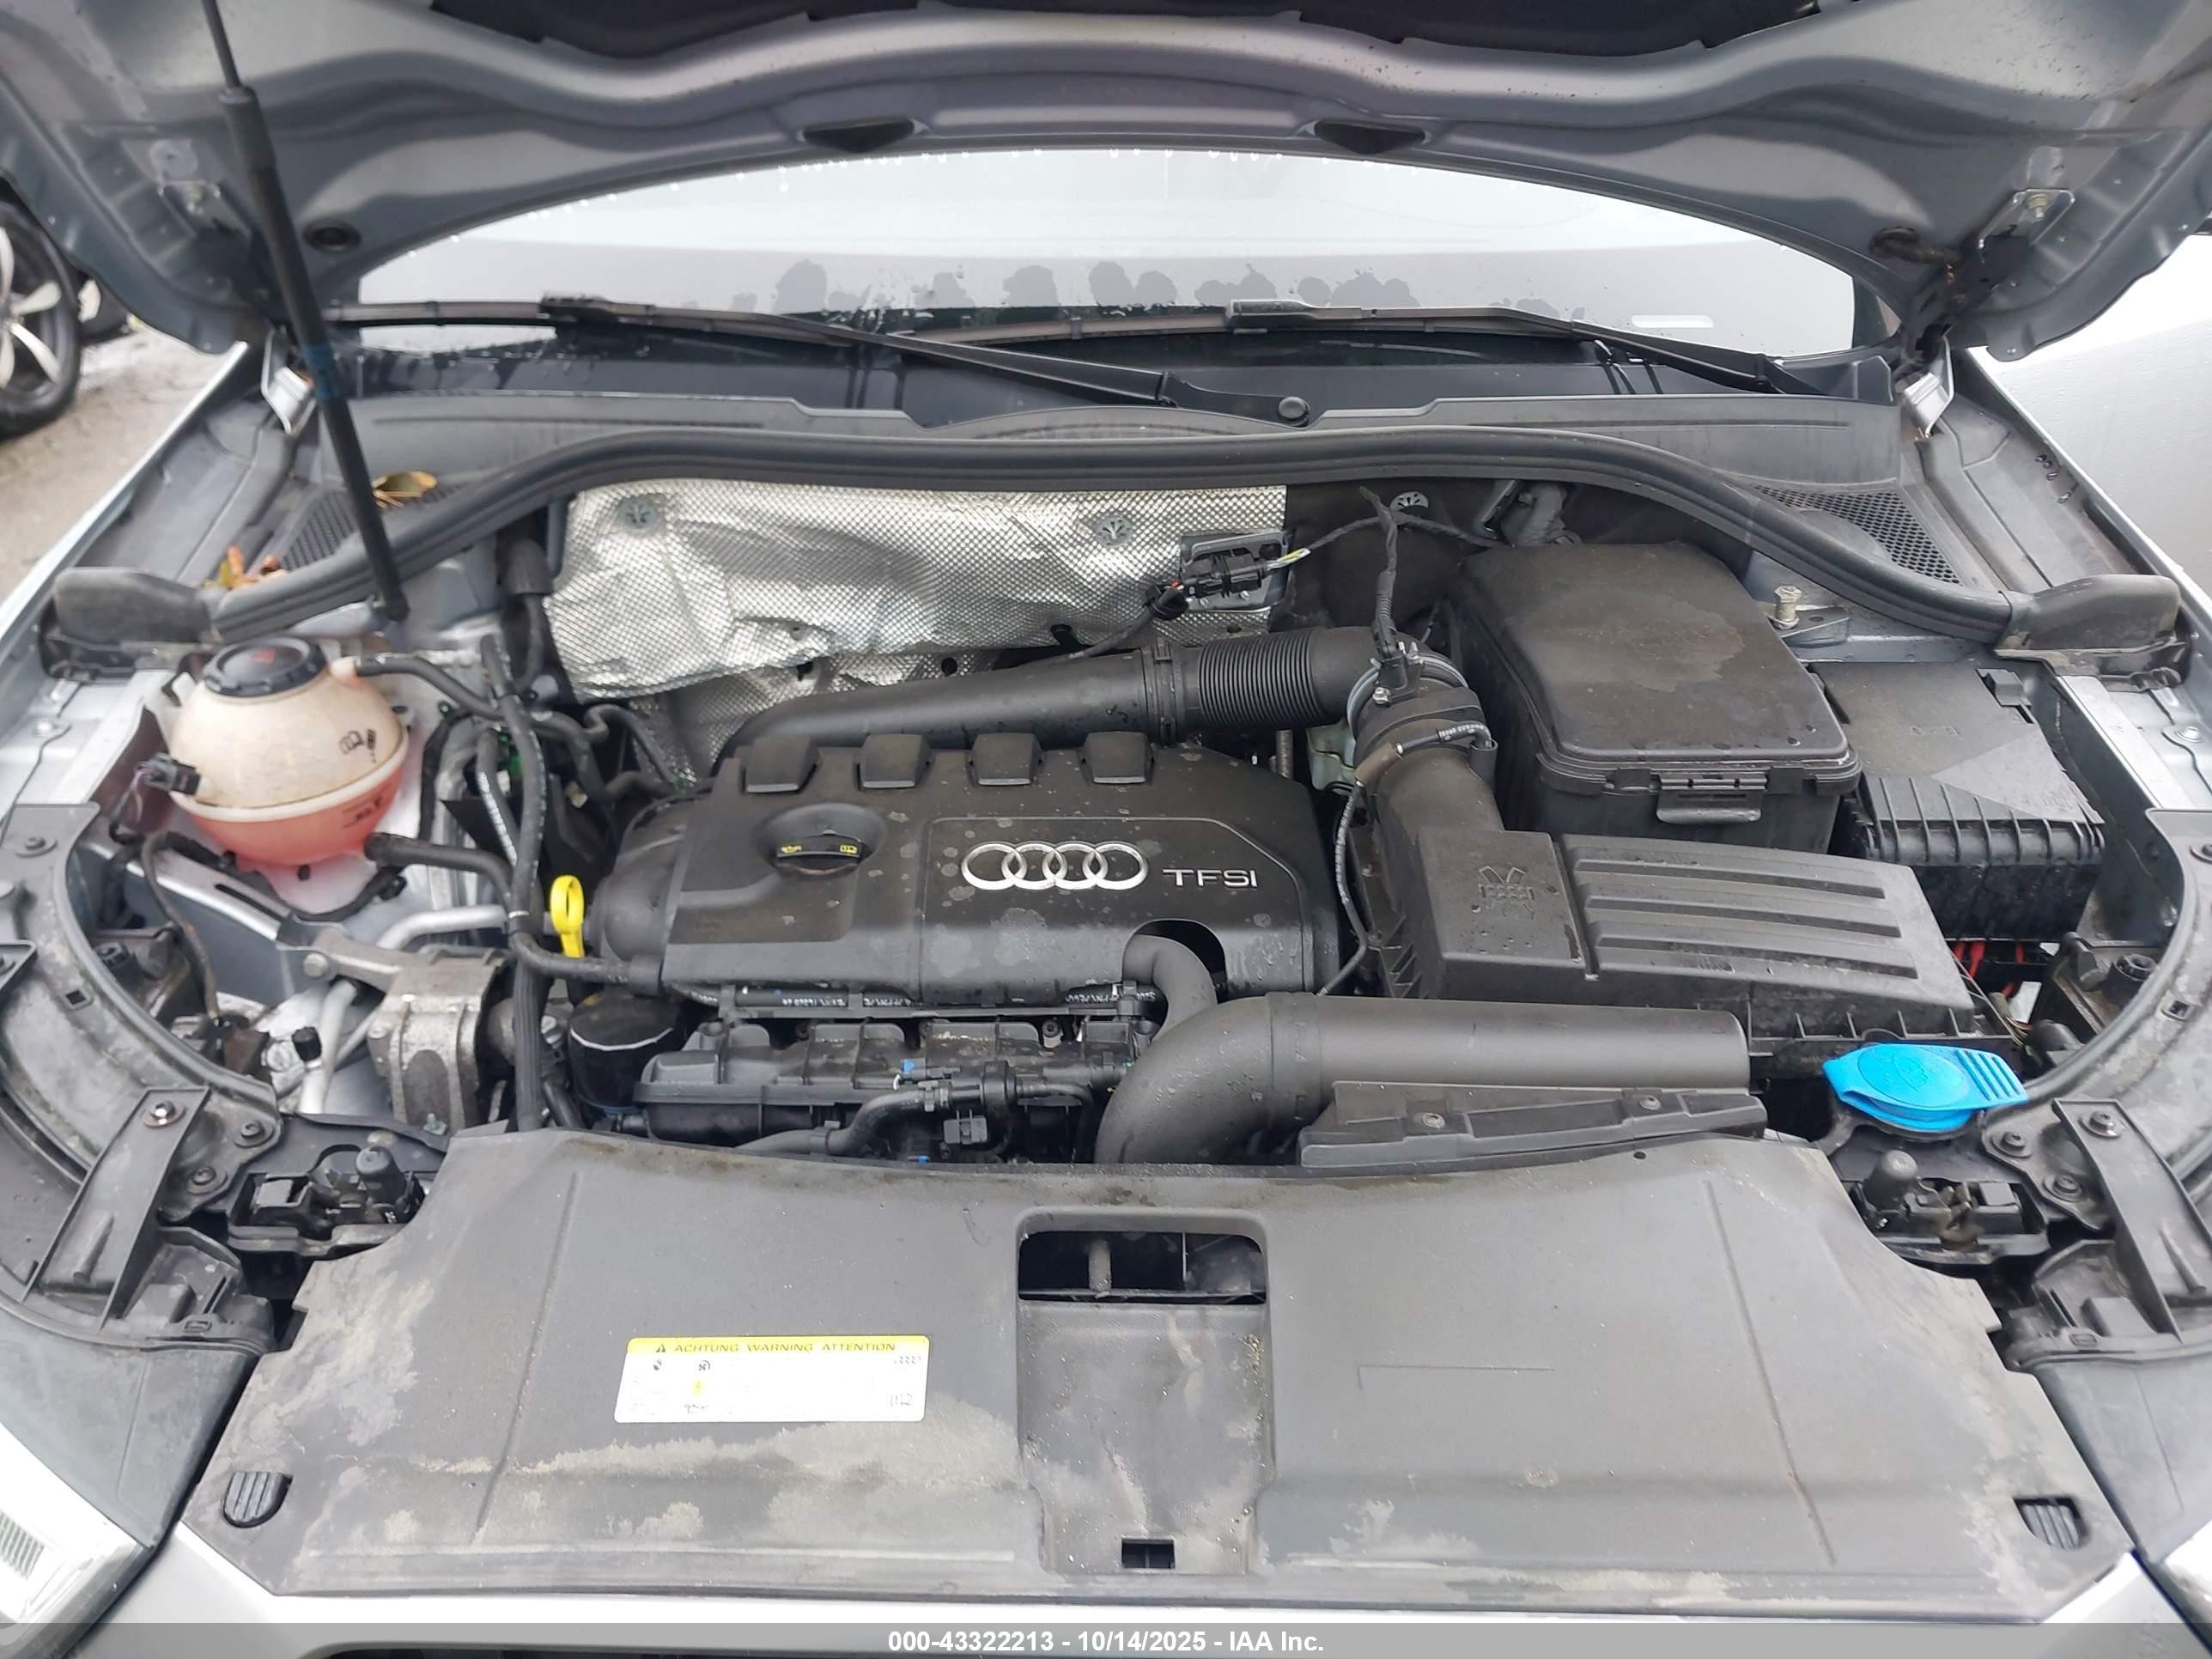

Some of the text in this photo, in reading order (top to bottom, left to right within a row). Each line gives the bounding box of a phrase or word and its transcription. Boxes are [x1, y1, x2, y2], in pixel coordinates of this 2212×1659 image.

[1162, 869, 1258, 888] TFSI
[674, 1343, 896, 1352] ACHTUNG WARNING ATTENTION
